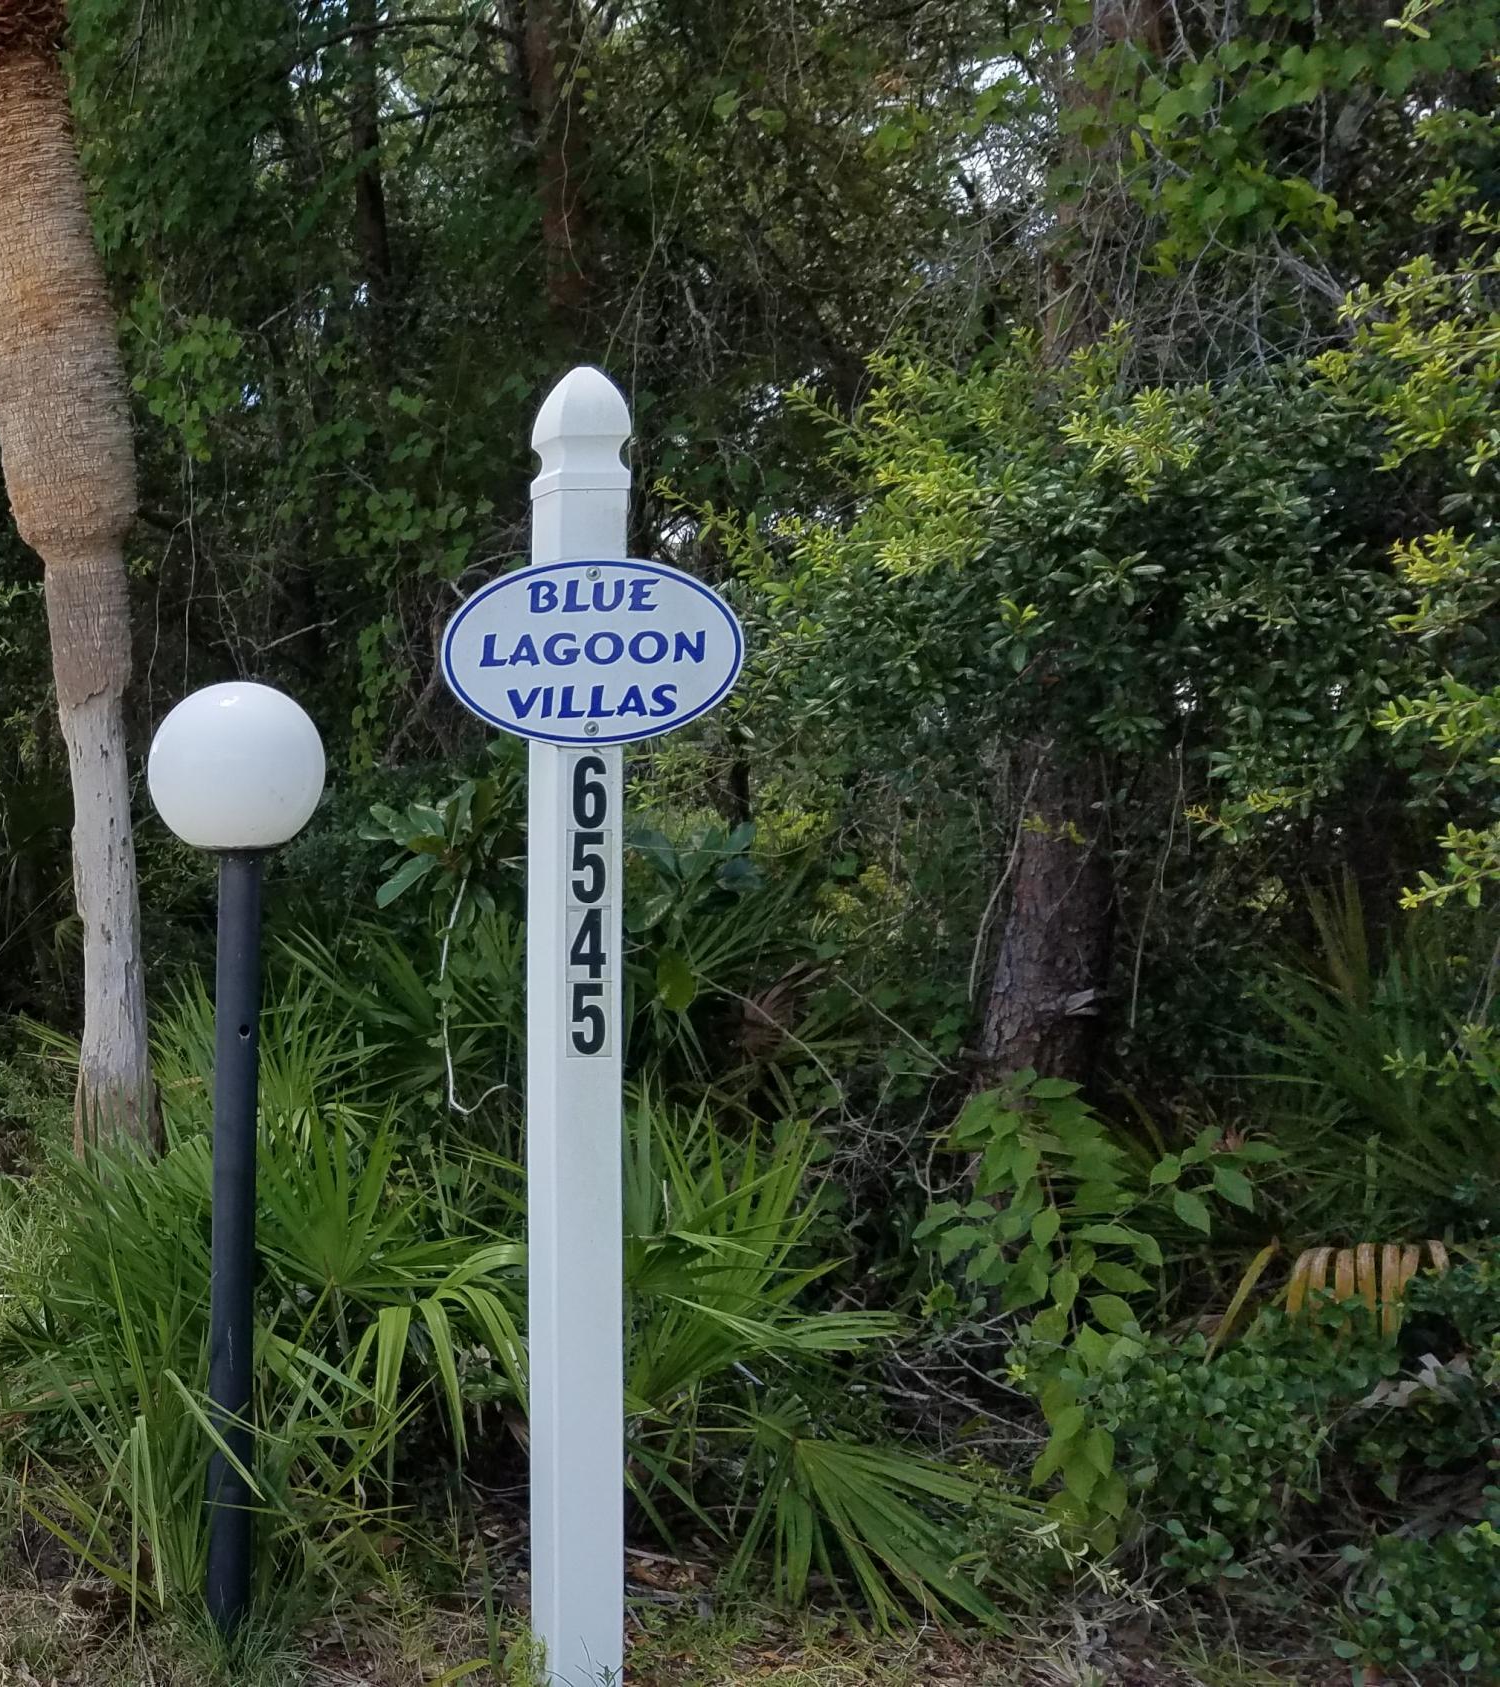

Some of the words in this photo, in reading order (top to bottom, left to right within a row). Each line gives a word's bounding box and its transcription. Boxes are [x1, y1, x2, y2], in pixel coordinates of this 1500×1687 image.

[526, 578, 661, 614] BLUE
[479, 630, 706, 668] LAGOON
[506, 684, 678, 720] VILLAS
[570, 755, 608, 1056] 6545
